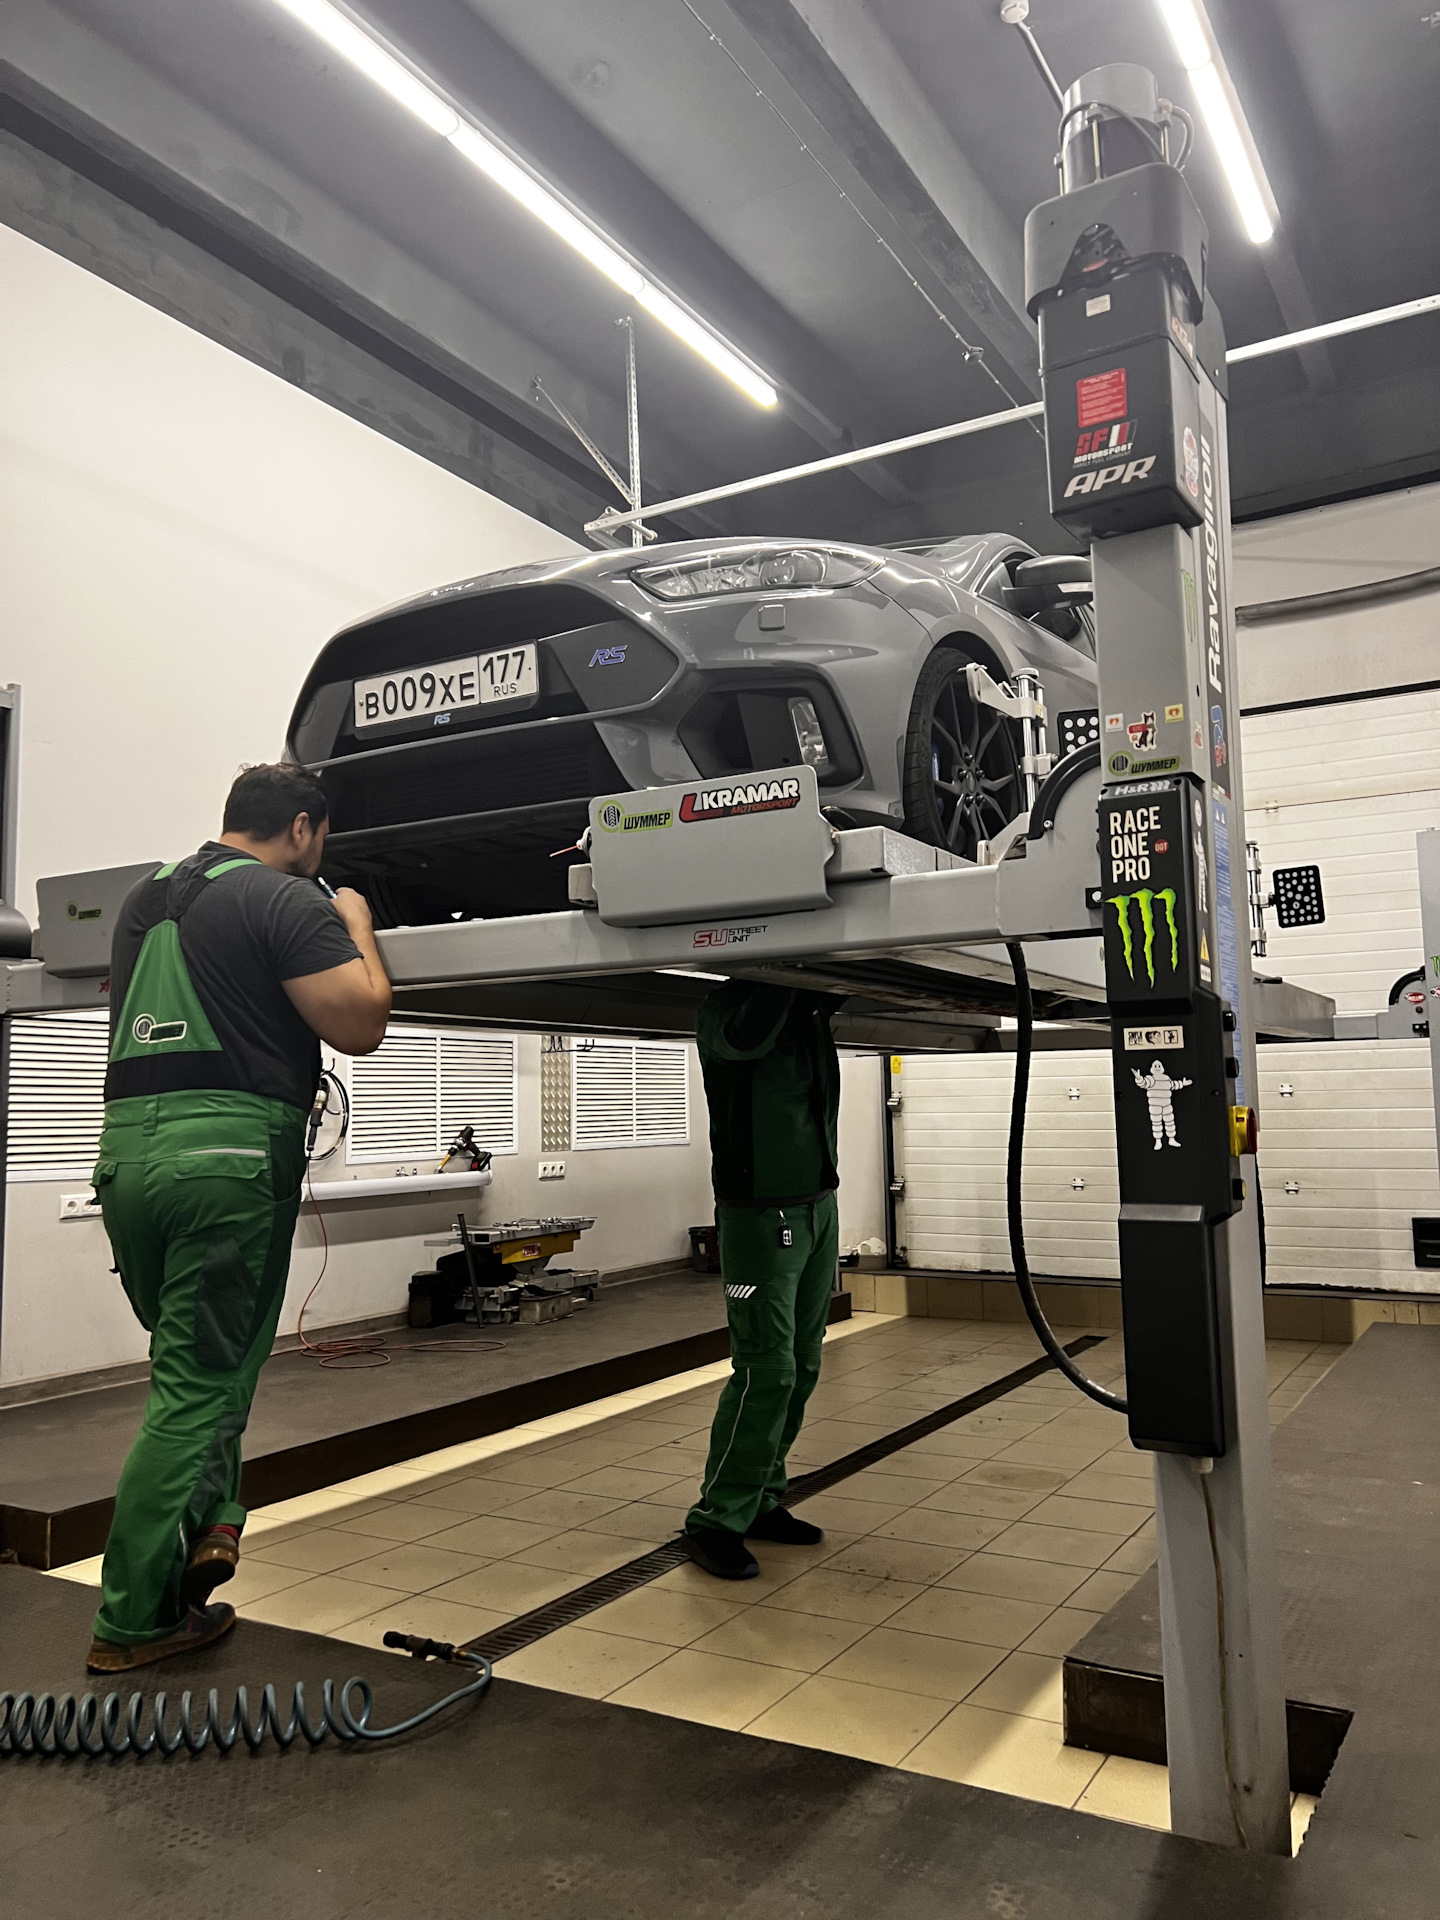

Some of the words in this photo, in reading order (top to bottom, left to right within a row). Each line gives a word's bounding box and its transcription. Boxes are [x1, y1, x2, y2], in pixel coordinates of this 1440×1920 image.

[1073, 442, 1133, 464] MOTORSPORT
[1063, 455, 1157, 498] APR
[1200, 434, 1223, 694] Ravaglioli
[588, 644, 628, 668] RS
[482, 650, 525, 685] 177
[493, 682, 517, 697] RUS
[433, 712, 451, 725] RS
[1131, 758, 1176, 774] ШУММЕР
[702, 779, 799, 810] KRAMAR
[1114, 783, 1149, 796] H&R
[730, 798, 799, 816] MOTORSPORT
[623, 812, 671, 831] ШУММЕР
[1109, 805, 1162, 836] RACE
[1110, 831, 1150, 859] ONE
[1111, 856, 1151, 884] PRO
[693, 928, 728, 948] SU
[727, 935, 751, 943] UNIT
[728, 925, 768, 936] STREET
